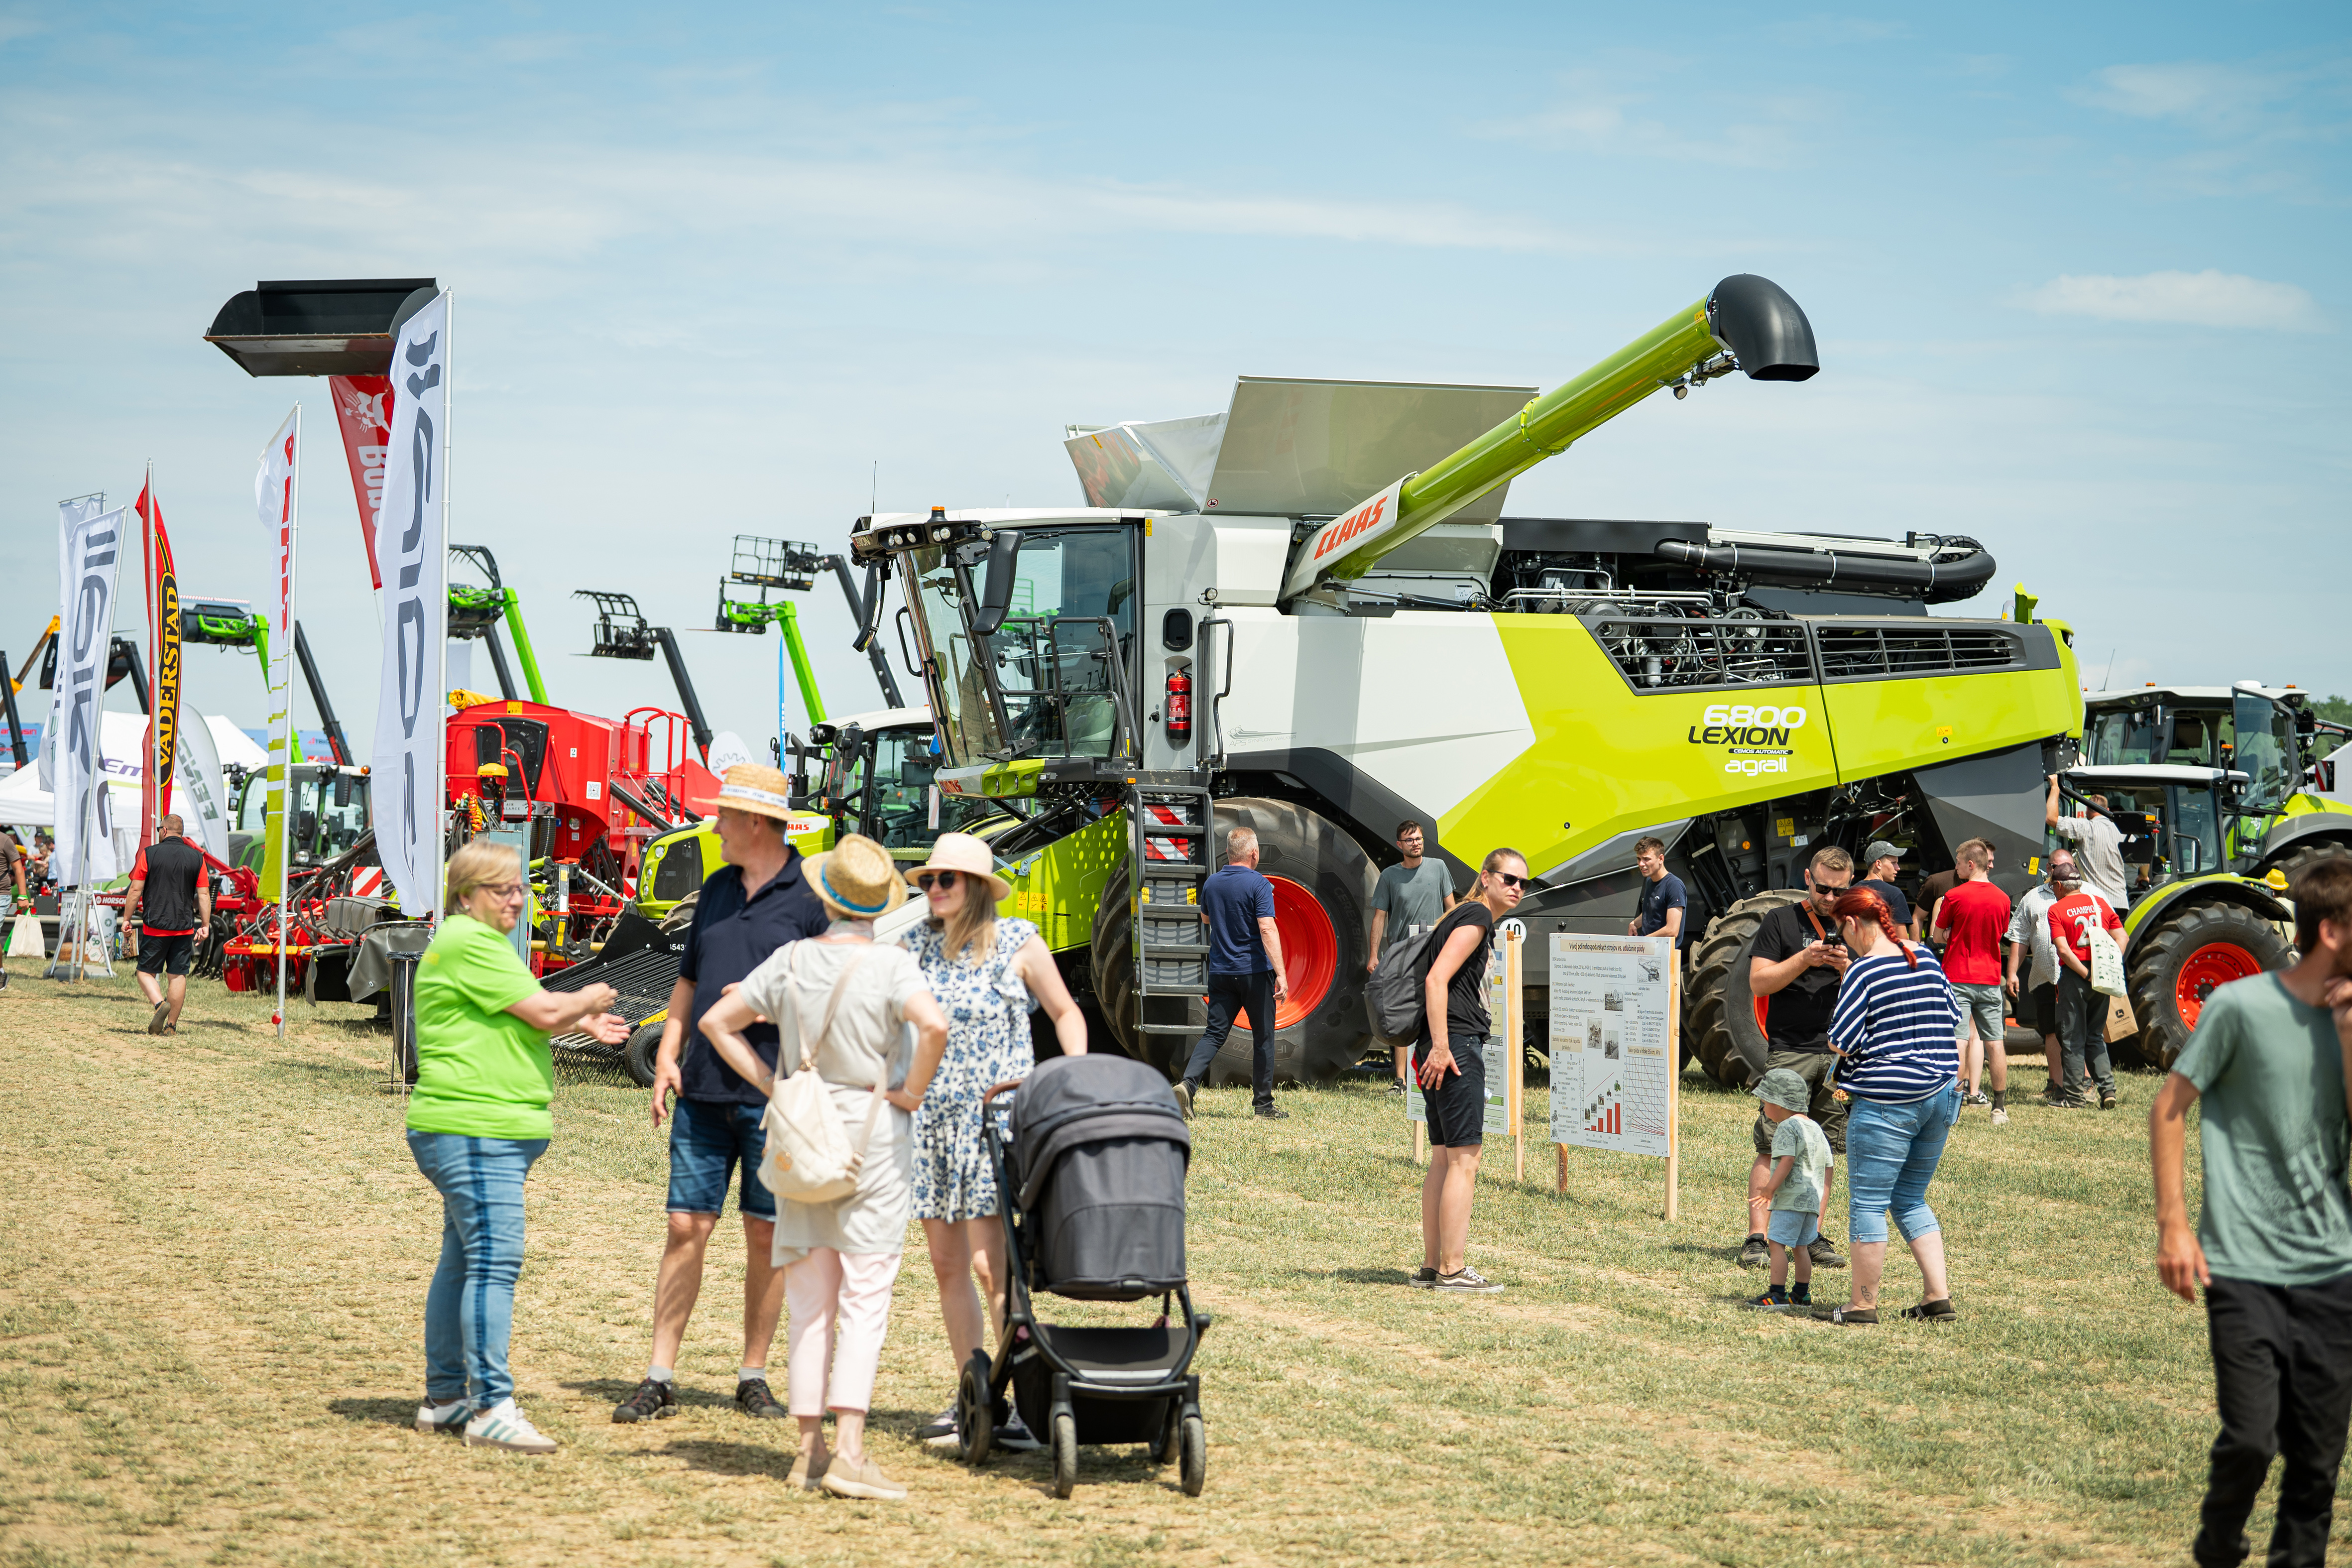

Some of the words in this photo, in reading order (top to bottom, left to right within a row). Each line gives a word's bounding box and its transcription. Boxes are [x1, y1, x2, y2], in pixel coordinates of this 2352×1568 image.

[1314, 495, 1388, 560] CLAAS
[1703, 705, 1806, 728] 6800
[1688, 726, 1790, 745] LEXION
[1725, 757, 1787, 776] agrall
[1578, 943, 1607, 952] poľnohospodárskych
